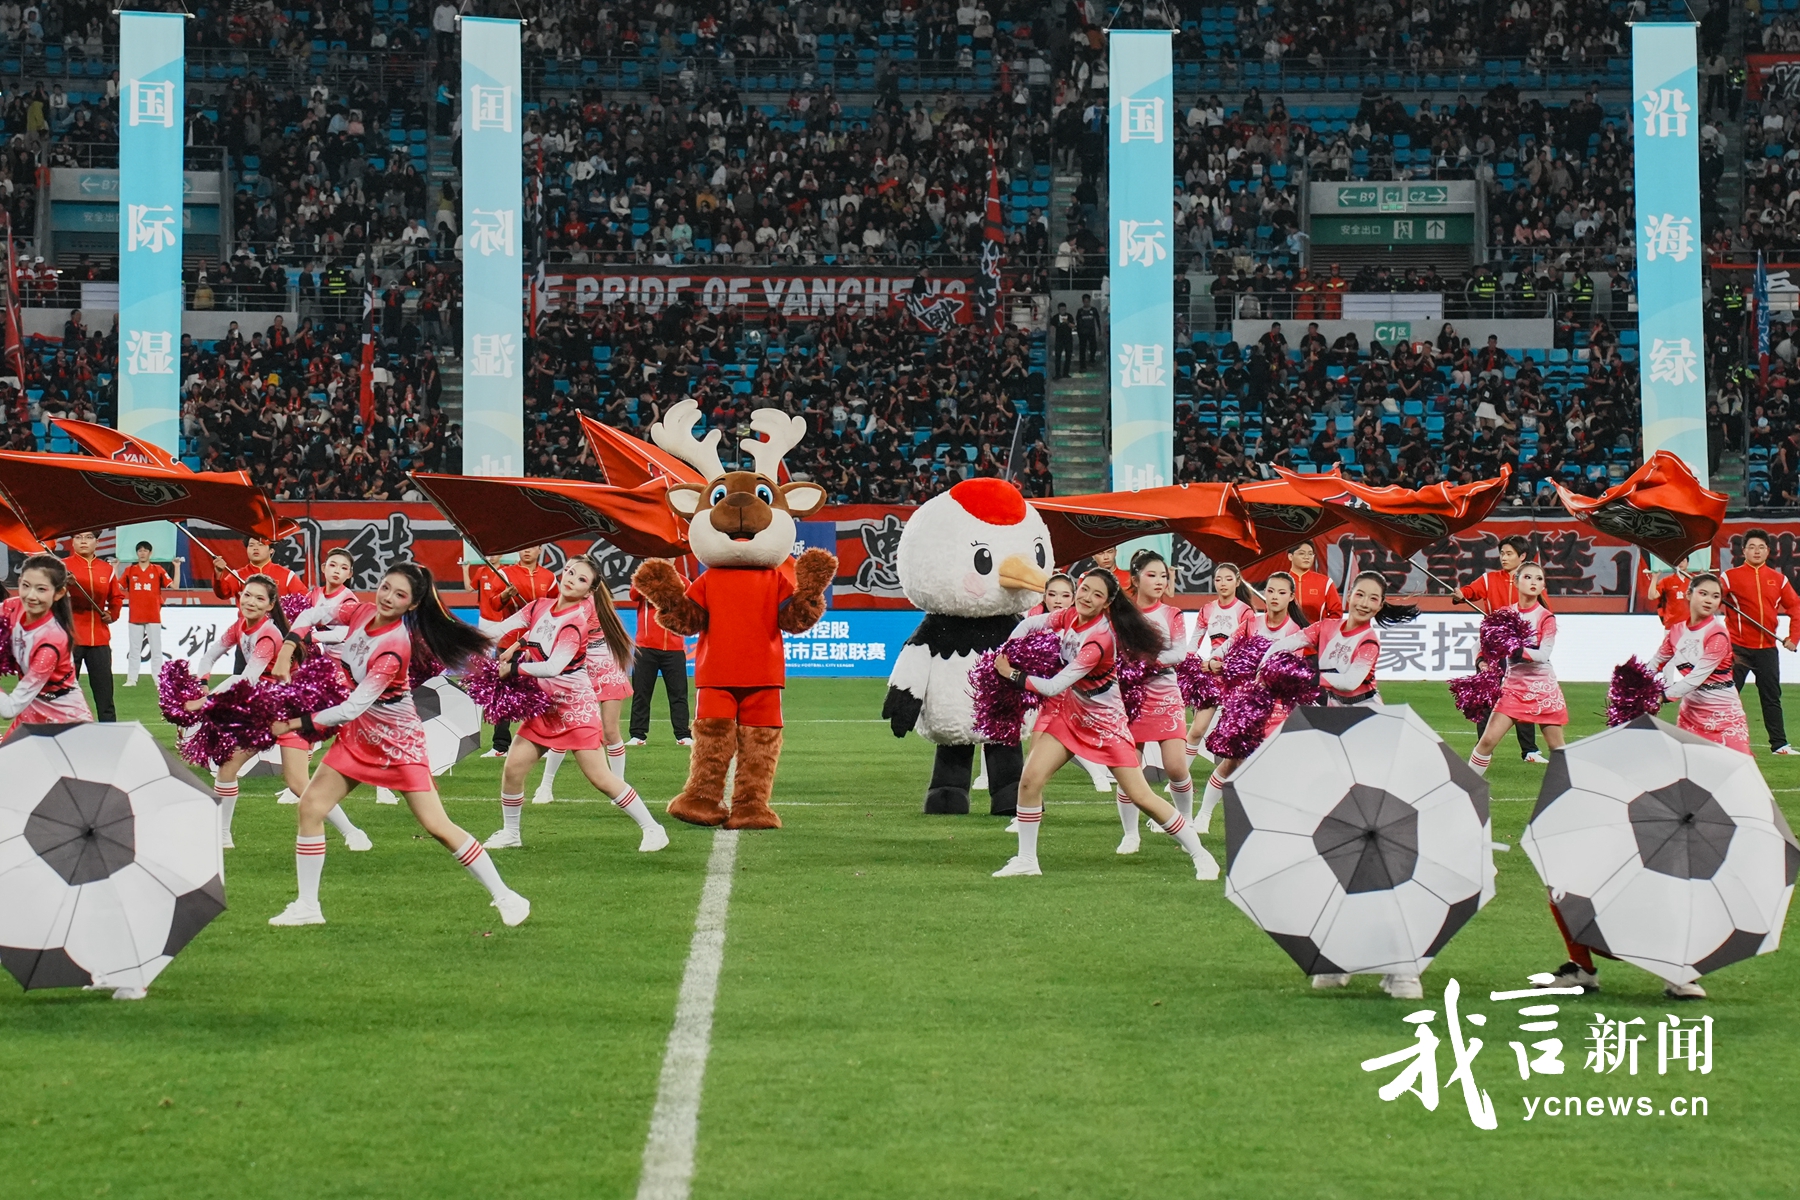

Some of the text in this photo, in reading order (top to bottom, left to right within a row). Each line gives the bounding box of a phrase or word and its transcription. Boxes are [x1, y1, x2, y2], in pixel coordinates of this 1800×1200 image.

[1360, 191, 1426, 203] B9 C1 C2
[127, 78, 176, 376] 国际湿
[1340, 225, 1381, 235] 安全出口
[1642, 88, 1699, 474] 沿海绿
[576, 276, 691, 316] PRIDE
[703, 276, 751, 315] OF
[122, 452, 154, 465] YAN
[134, 582, 152, 591] 盐城
[1372, 621, 1481, 673] 豪控
